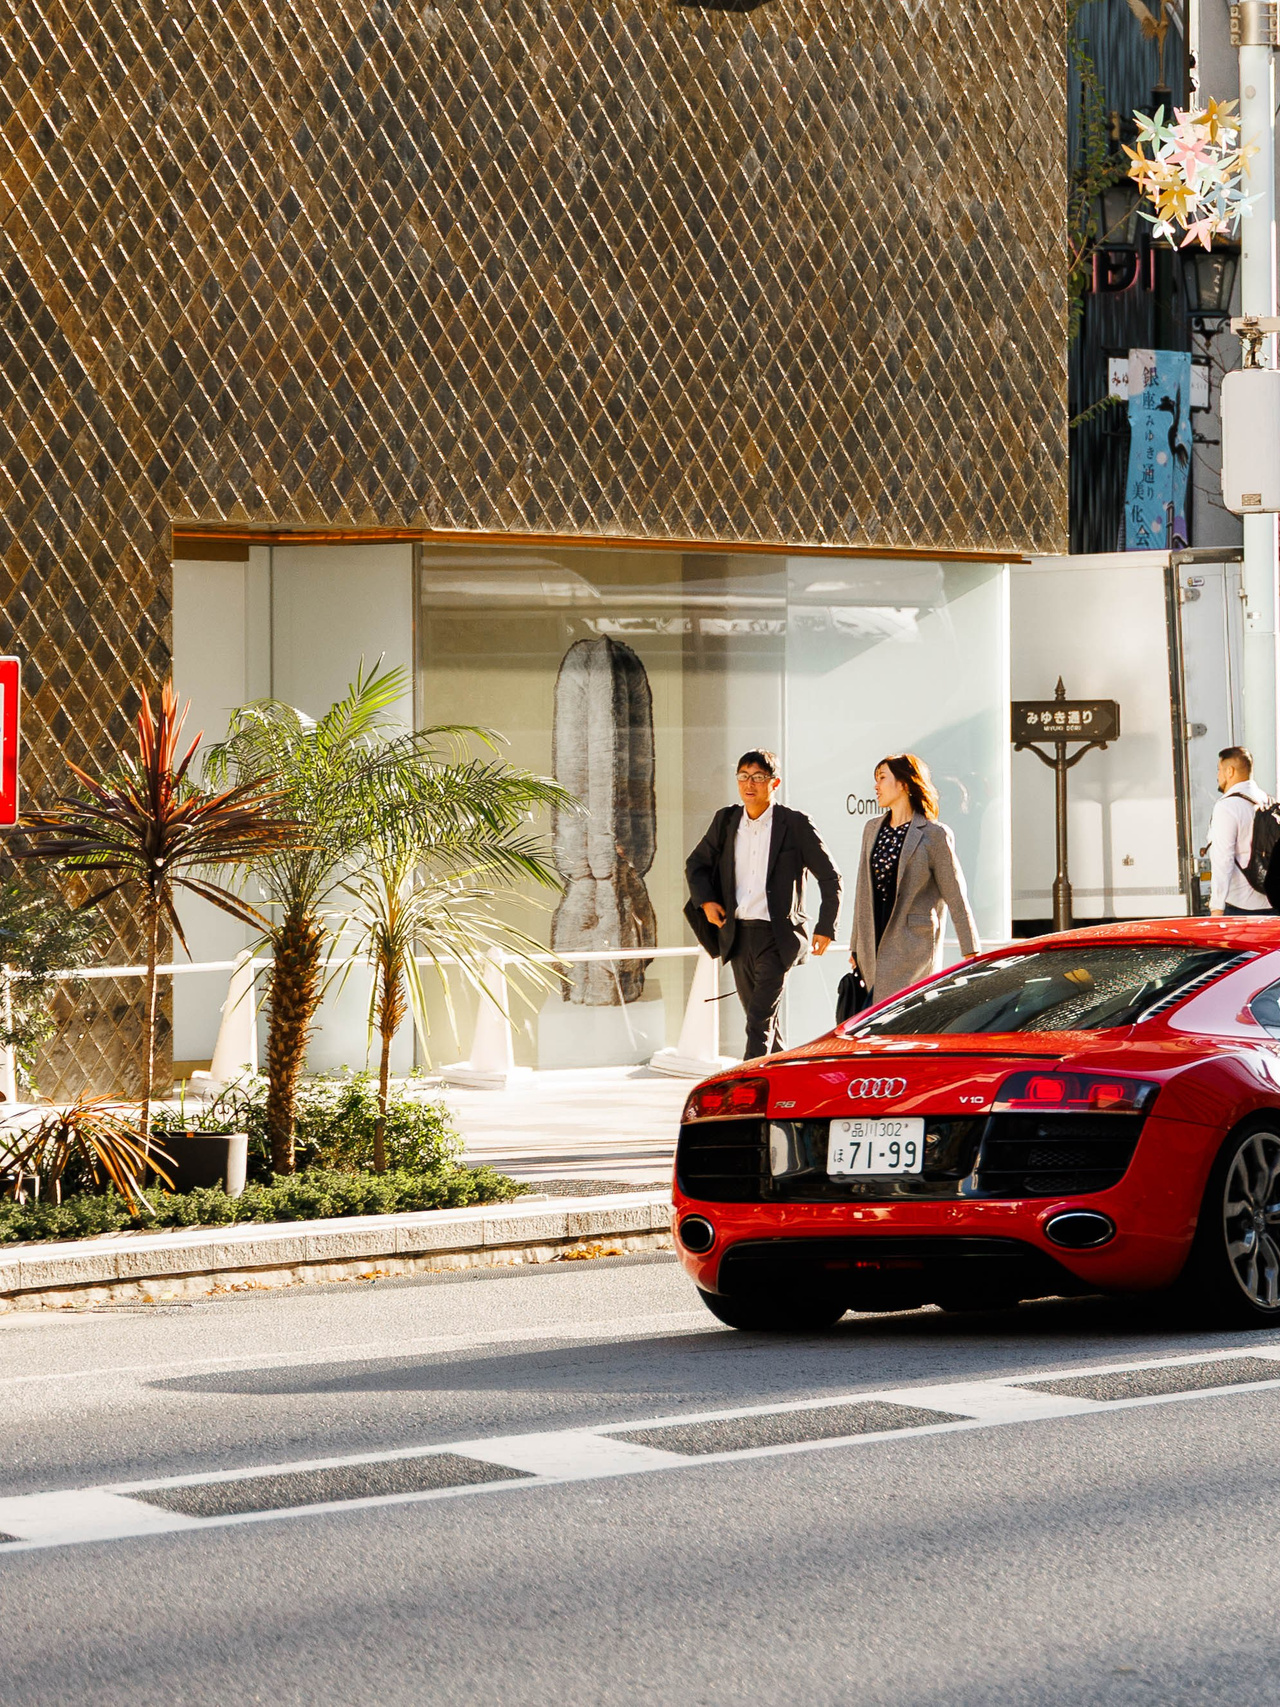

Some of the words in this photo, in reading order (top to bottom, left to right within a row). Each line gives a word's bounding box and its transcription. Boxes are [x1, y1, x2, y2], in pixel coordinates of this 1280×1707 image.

[1142, 366, 1160, 500] 銀座みゆき通り
[1131, 482, 1150, 547] 美化会
[1026, 710, 1093, 725] みゆき通り
[1043, 724, 1064, 732] MIYUKI
[833, 1148, 844, 1163] ほ
[849, 1141, 917, 1170] 71-99
